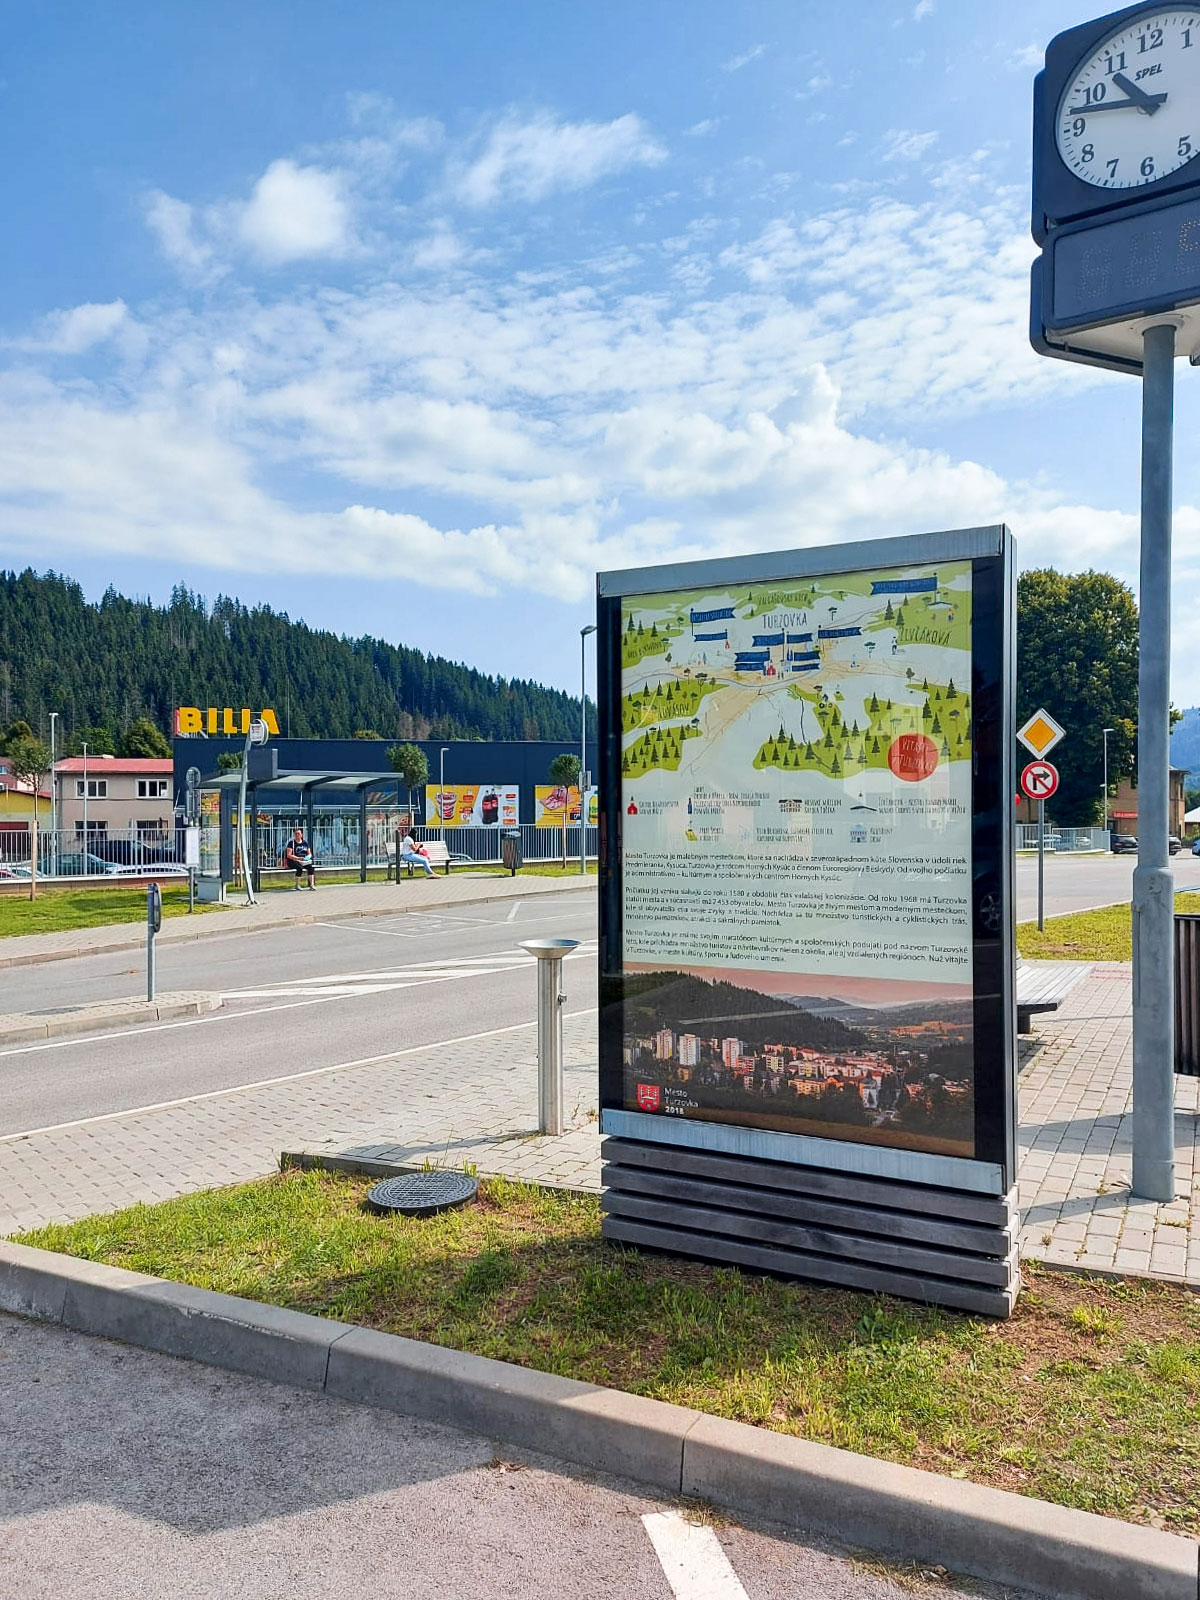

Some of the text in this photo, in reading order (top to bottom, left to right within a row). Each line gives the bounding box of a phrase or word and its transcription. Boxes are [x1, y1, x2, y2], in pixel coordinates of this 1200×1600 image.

[1136, 28, 1164, 54] 12
[1180, 28, 1192, 49] 1
[1104, 52, 1128, 76] 11
[1134, 63, 1162, 81] SPEL
[1082, 82, 1106, 106] 10
[1072, 118, 1086, 137] 9
[1082, 144, 1094, 162] 8
[1178, 136, 1192, 156] 5
[1106, 159, 1120, 178] 7
[1140, 156, 1154, 176] 6
[762, 612, 808, 628] TURZOVKA
[178, 706, 280, 735] BILLA
[664, 1097, 698, 1108] Turzovka
[665, 1106, 684, 1114] 2018
